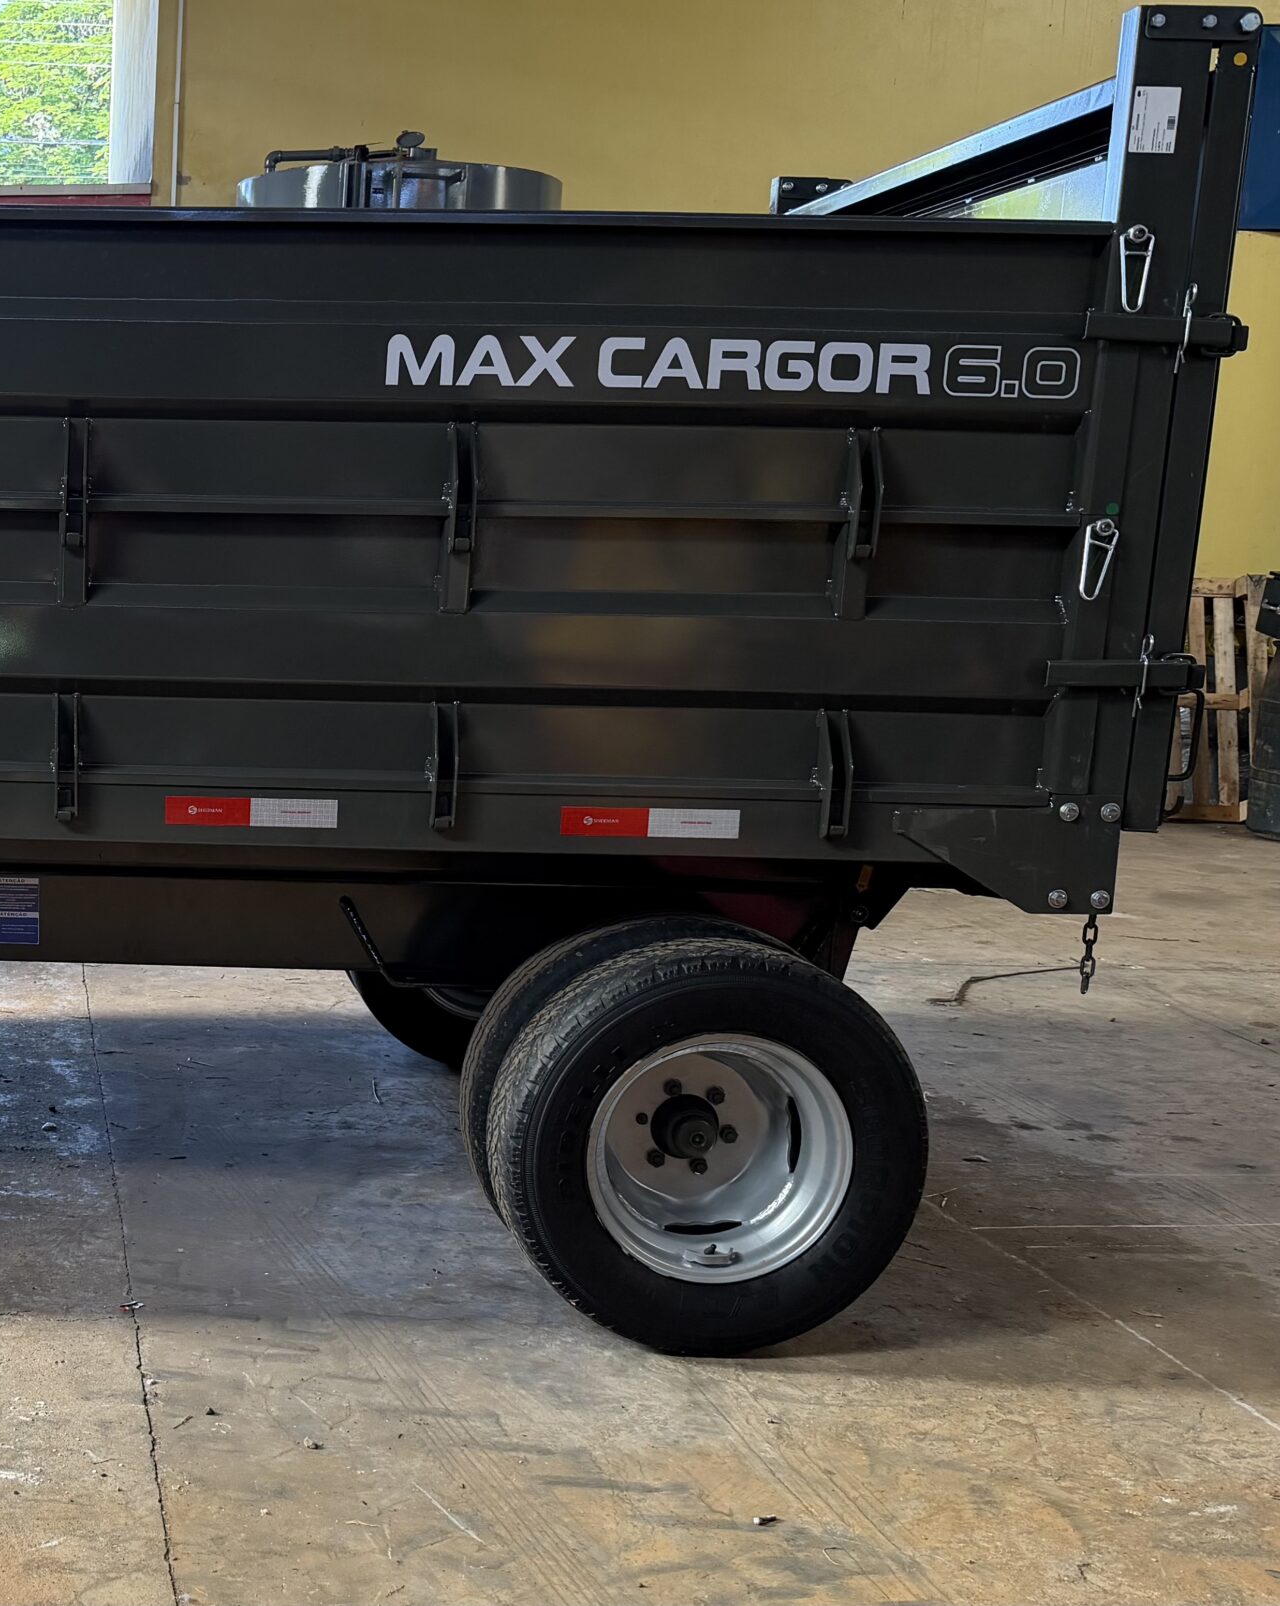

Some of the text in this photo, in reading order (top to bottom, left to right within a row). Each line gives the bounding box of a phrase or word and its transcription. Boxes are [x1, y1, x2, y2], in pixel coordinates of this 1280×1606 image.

[385, 333, 1082, 400] MAX CARGOR 6.0
